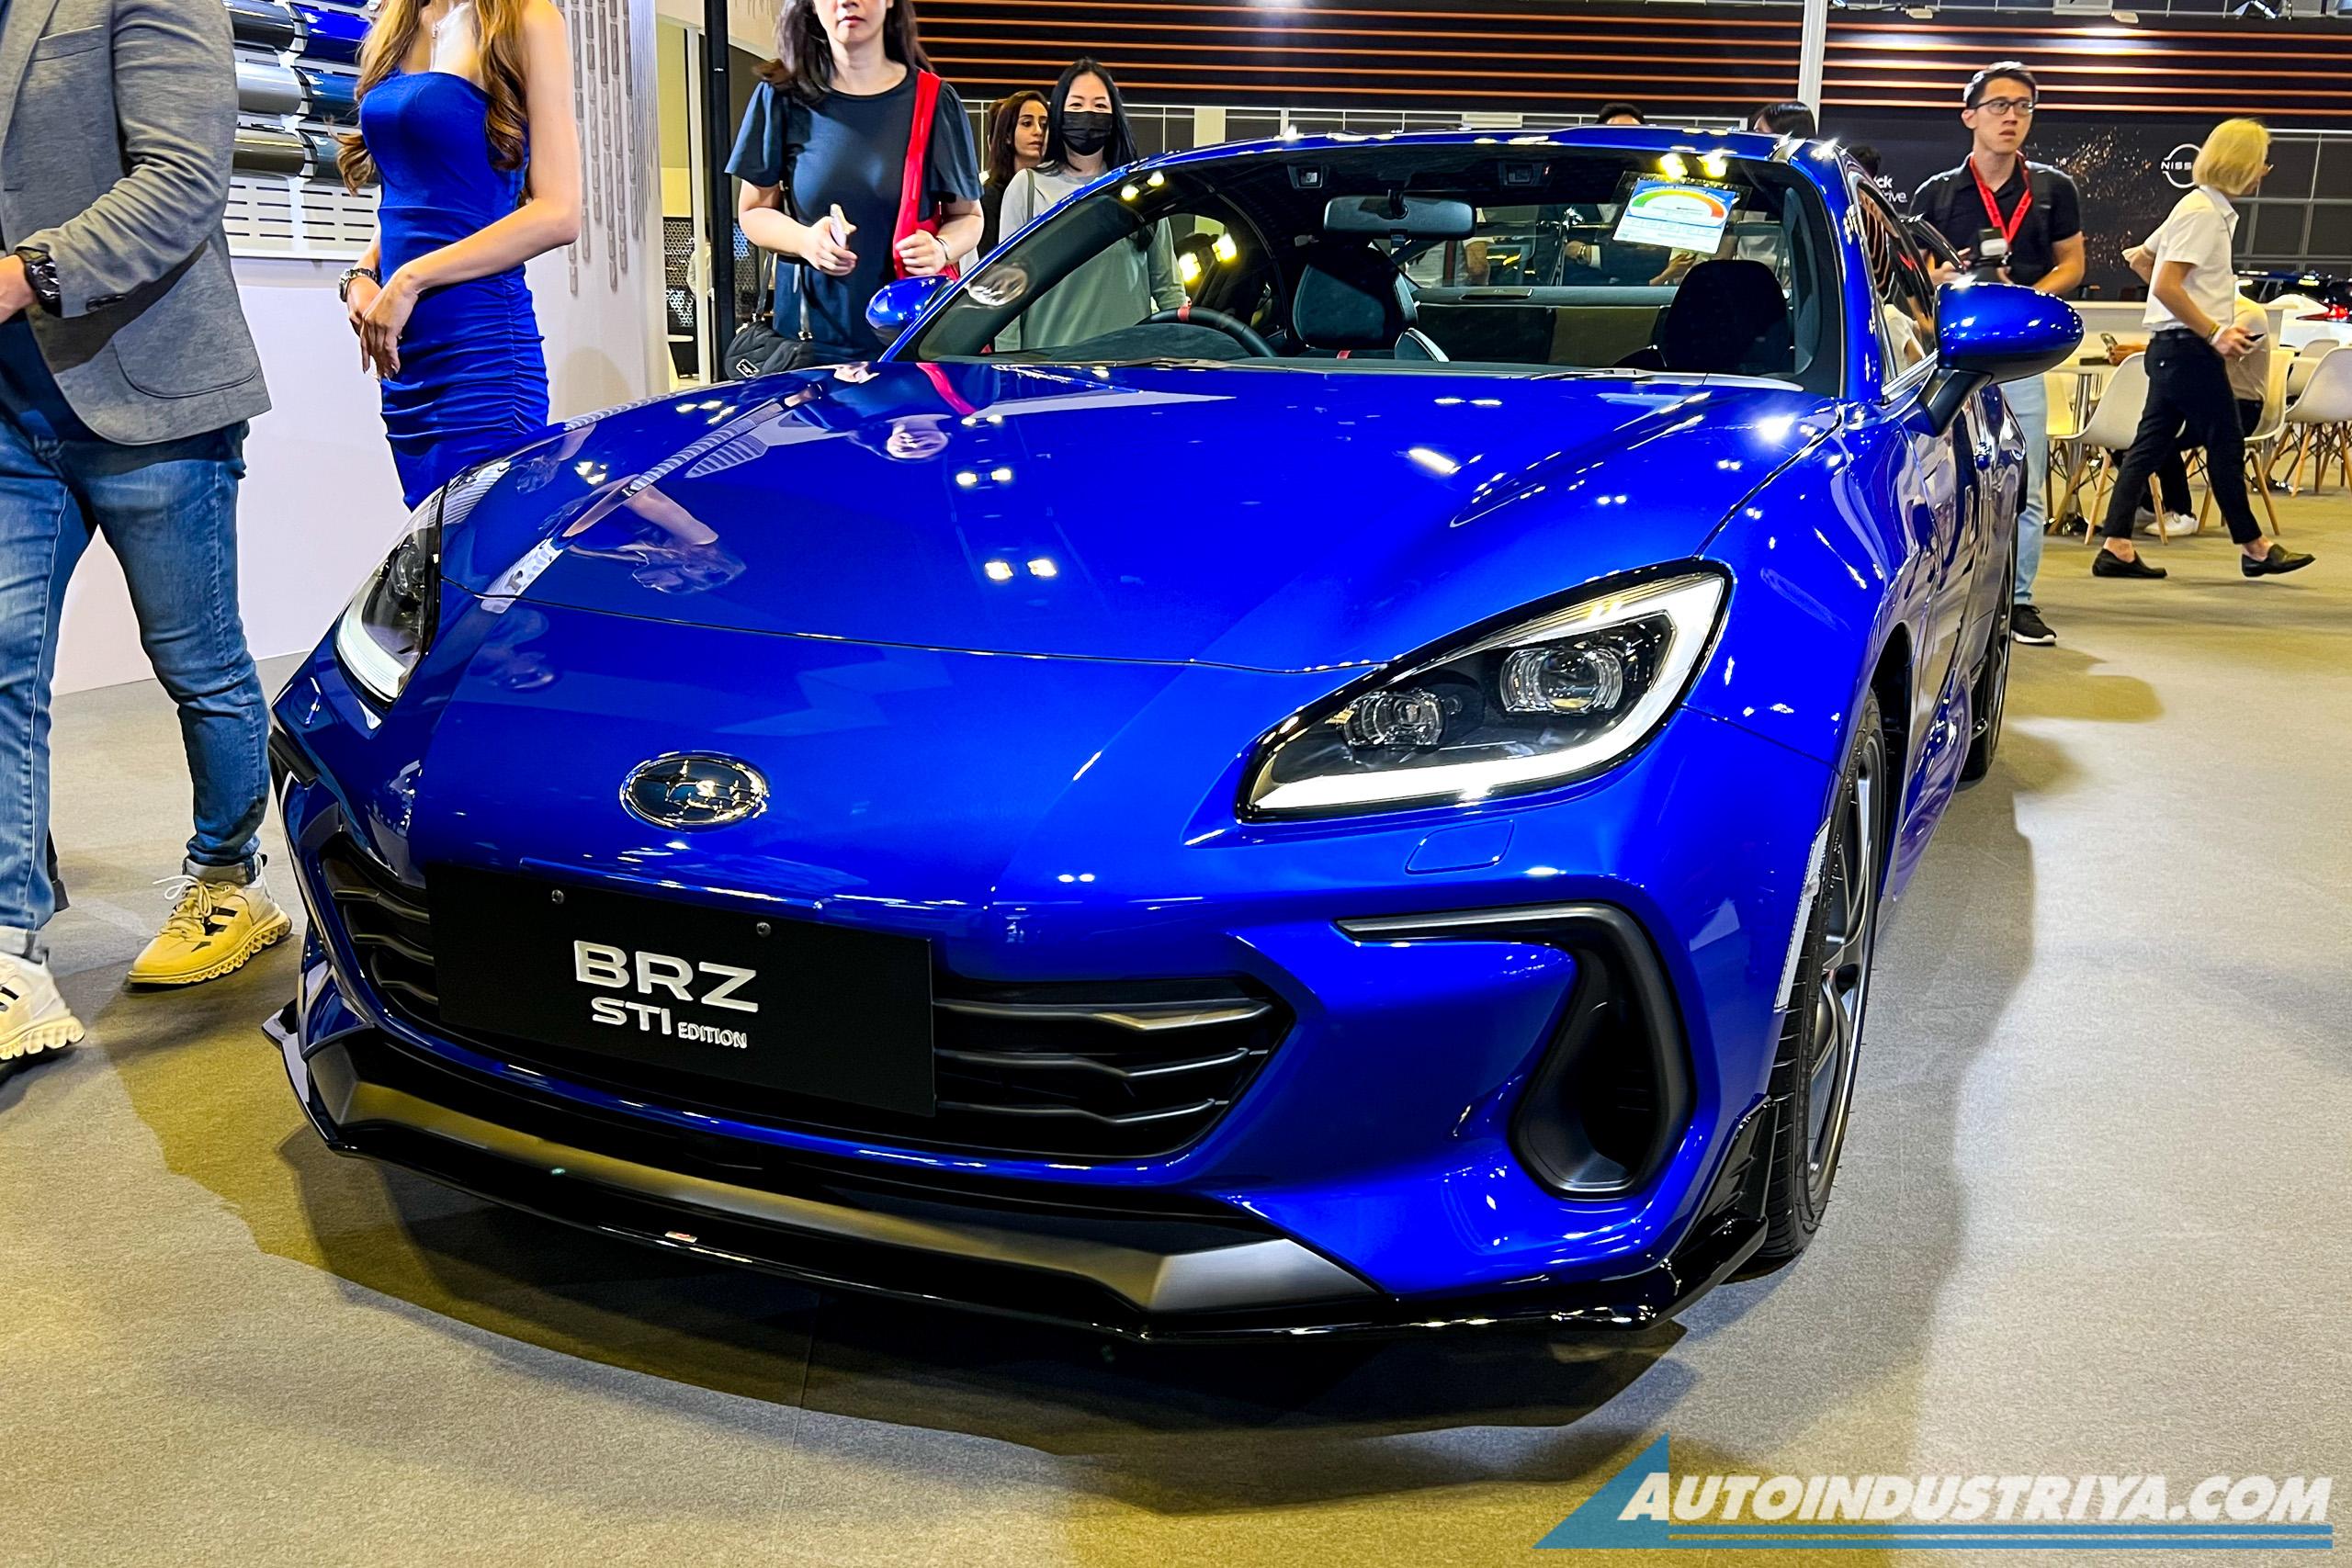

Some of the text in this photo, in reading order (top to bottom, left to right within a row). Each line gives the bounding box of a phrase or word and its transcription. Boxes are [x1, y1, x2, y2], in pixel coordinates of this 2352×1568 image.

[2161, 161, 2193, 171] NISS
[574, 940, 759, 1013] BRZ
[591, 997, 748, 1049] STI EDITION
